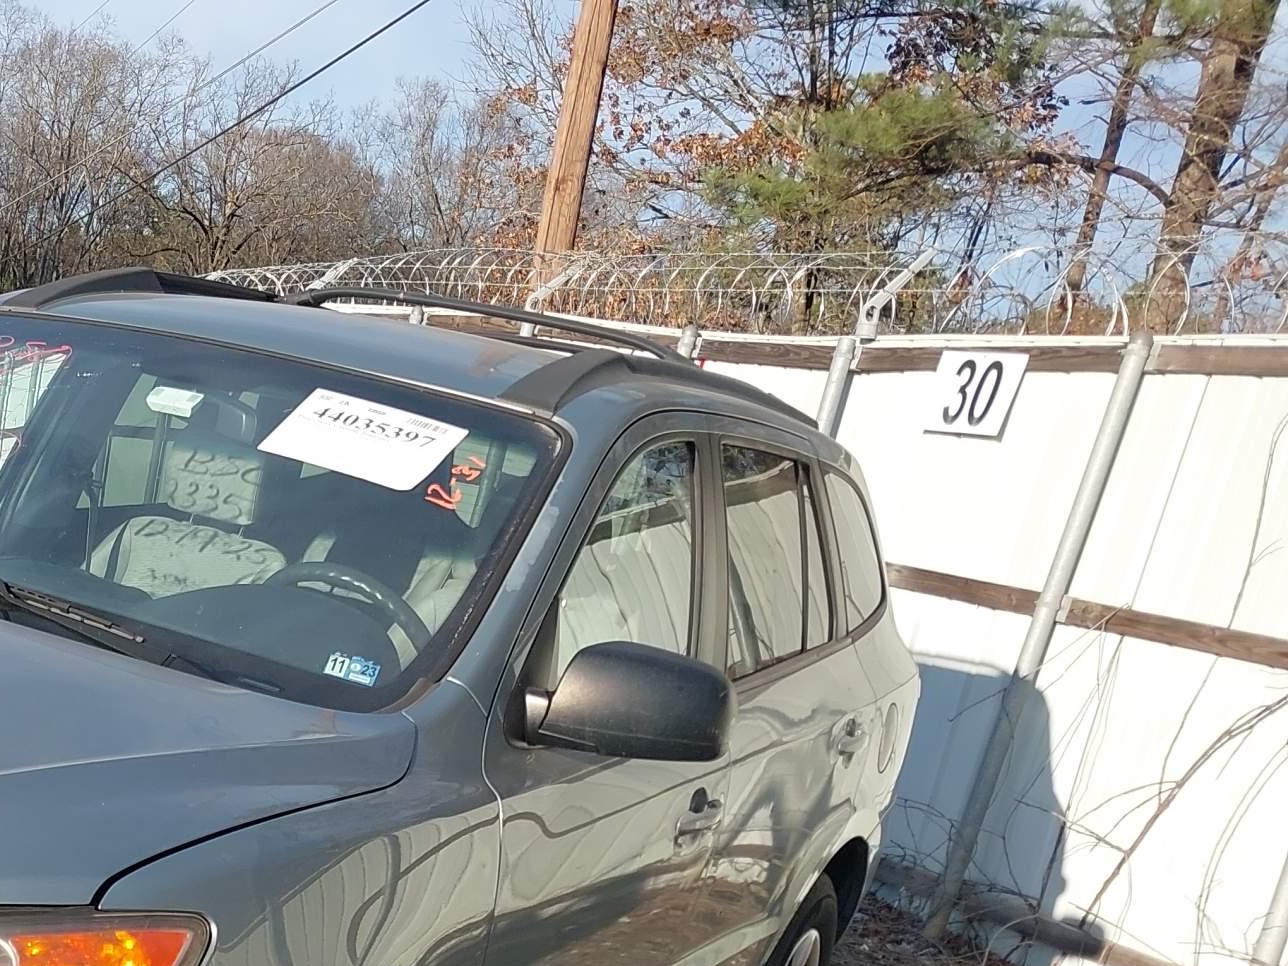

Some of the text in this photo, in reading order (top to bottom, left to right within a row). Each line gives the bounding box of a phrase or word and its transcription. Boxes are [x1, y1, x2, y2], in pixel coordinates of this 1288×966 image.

[942, 359, 1004, 427] 30
[313, 407, 436, 448] 44035397
[330, 657, 346, 673] 11
[360, 664, 377, 678] 23
